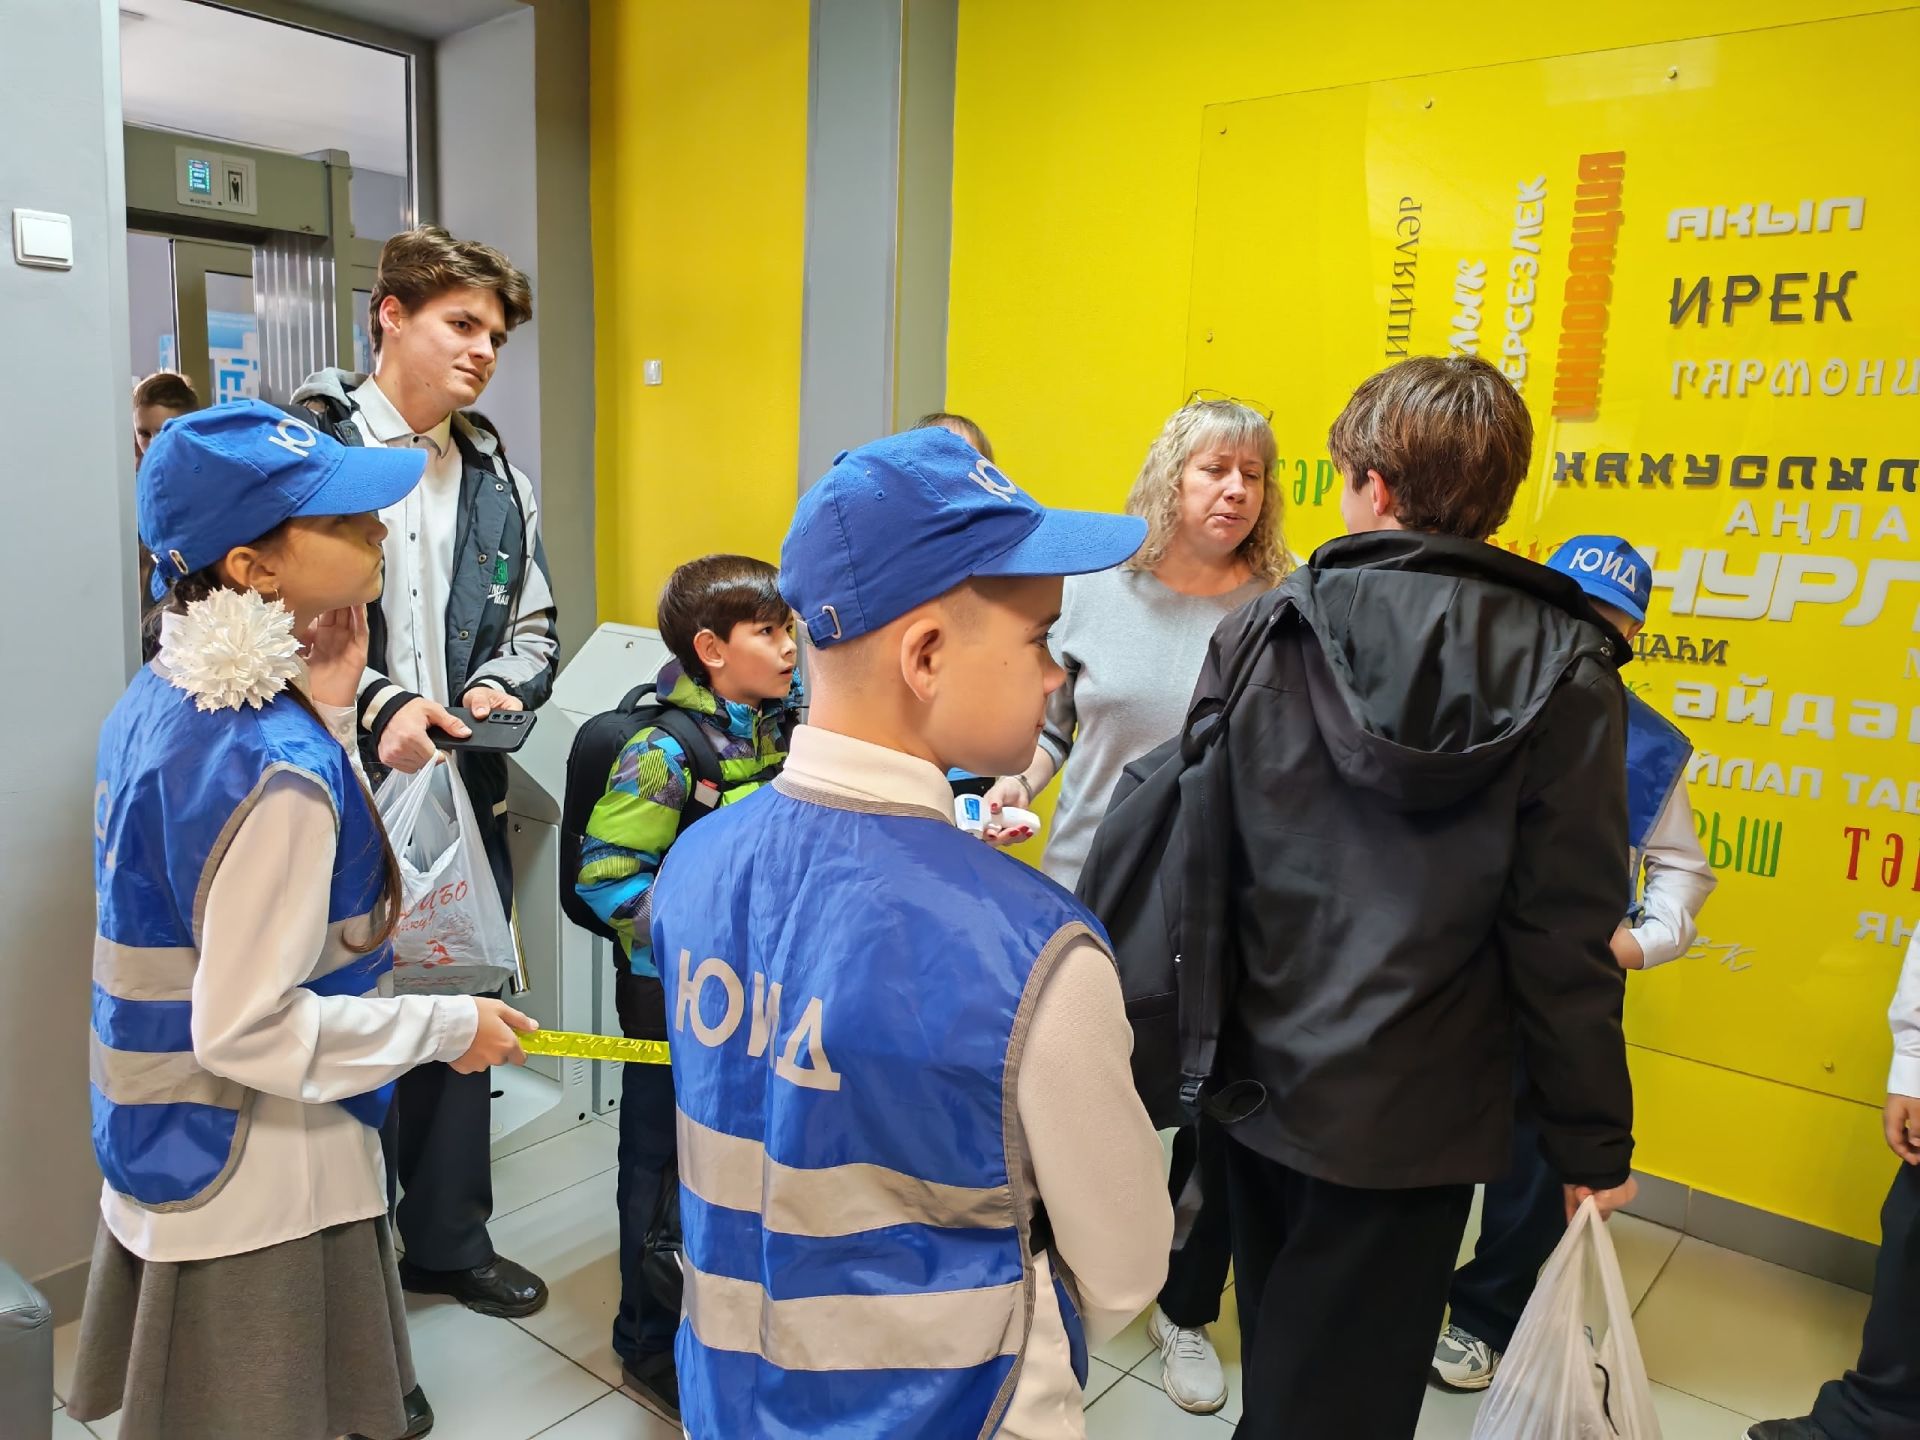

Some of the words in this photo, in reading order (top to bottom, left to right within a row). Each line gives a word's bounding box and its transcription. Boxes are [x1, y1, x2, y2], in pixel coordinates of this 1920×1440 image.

[1385, 196, 1422, 358] ИЦИЯЛӘР
[1500, 174, 1547, 393] ЕРСЕЗЛЕК
[1551, 150, 1625, 418] ИННОВАЦИЯ
[1668, 270, 1858, 325] ИРЕК
[1569, 547, 1638, 593] ЮИД
[675, 948, 842, 1092] ЮИД
